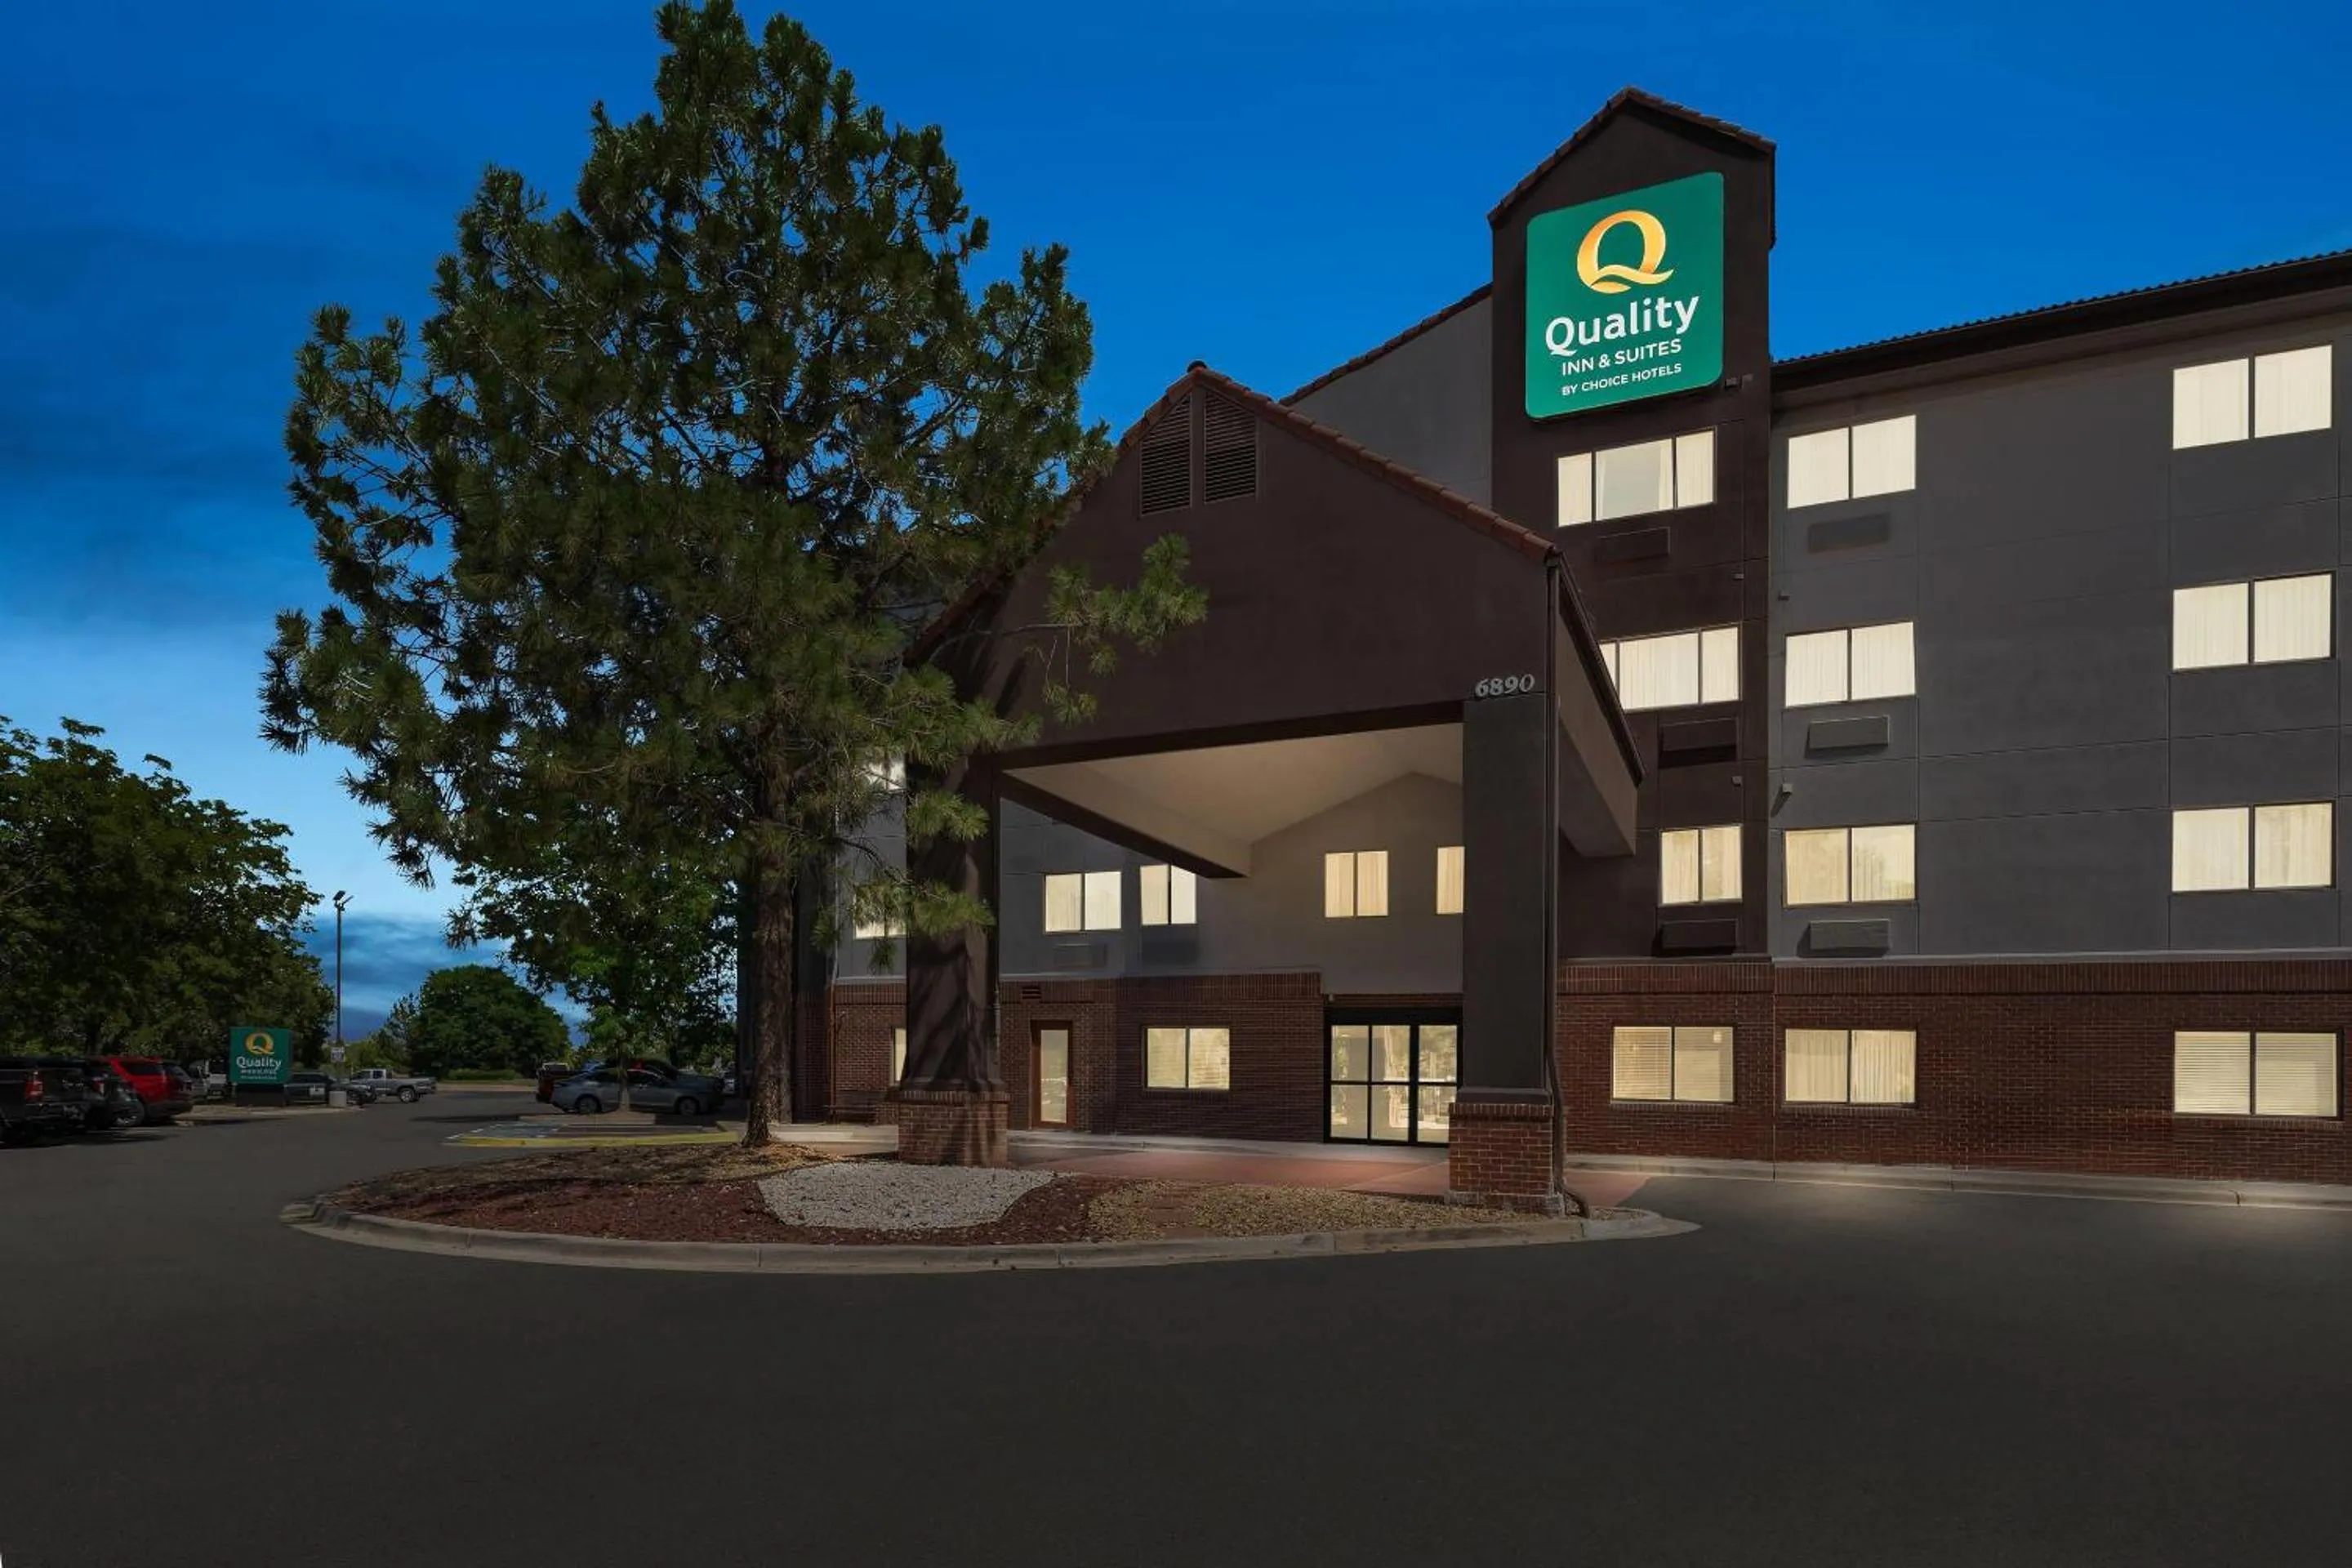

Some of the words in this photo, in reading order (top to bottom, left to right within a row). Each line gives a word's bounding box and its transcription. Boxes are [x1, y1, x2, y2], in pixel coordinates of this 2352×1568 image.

[1577, 210, 1673, 293] Q
[1546, 296, 1699, 356] Quality
[1562, 358, 1593, 375] INN
[1598, 354, 1610, 368] &
[1615, 339, 1682, 363] SUITES
[1561, 385, 1578, 396] BY
[1581, 375, 1628, 392] CHOICE
[1632, 363, 1682, 381] HOTELS
[1475, 674, 1535, 697] 6890
[246, 1032, 274, 1055] Q
[236, 1056, 282, 1071] Quality
